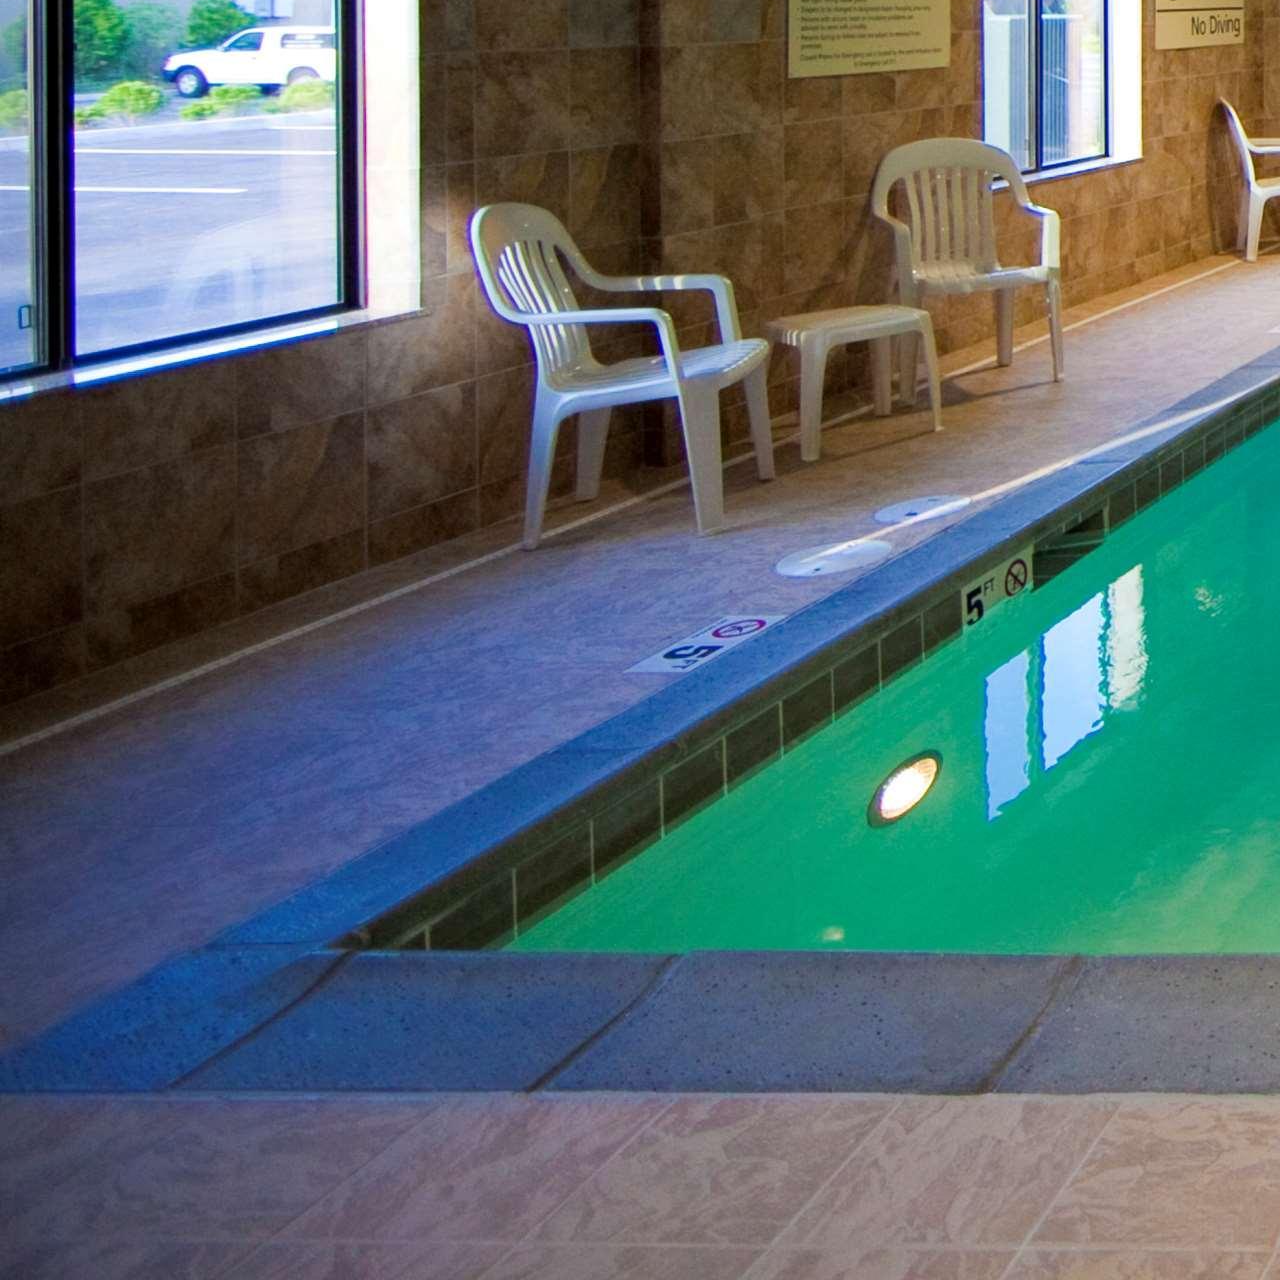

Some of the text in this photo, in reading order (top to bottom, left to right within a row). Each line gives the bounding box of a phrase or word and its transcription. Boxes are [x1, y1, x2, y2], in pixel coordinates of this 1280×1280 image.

[1191, 14, 1241, 37] No Diving
[966, 577, 995, 627] 5 FT
[662, 644, 725, 660] 5
